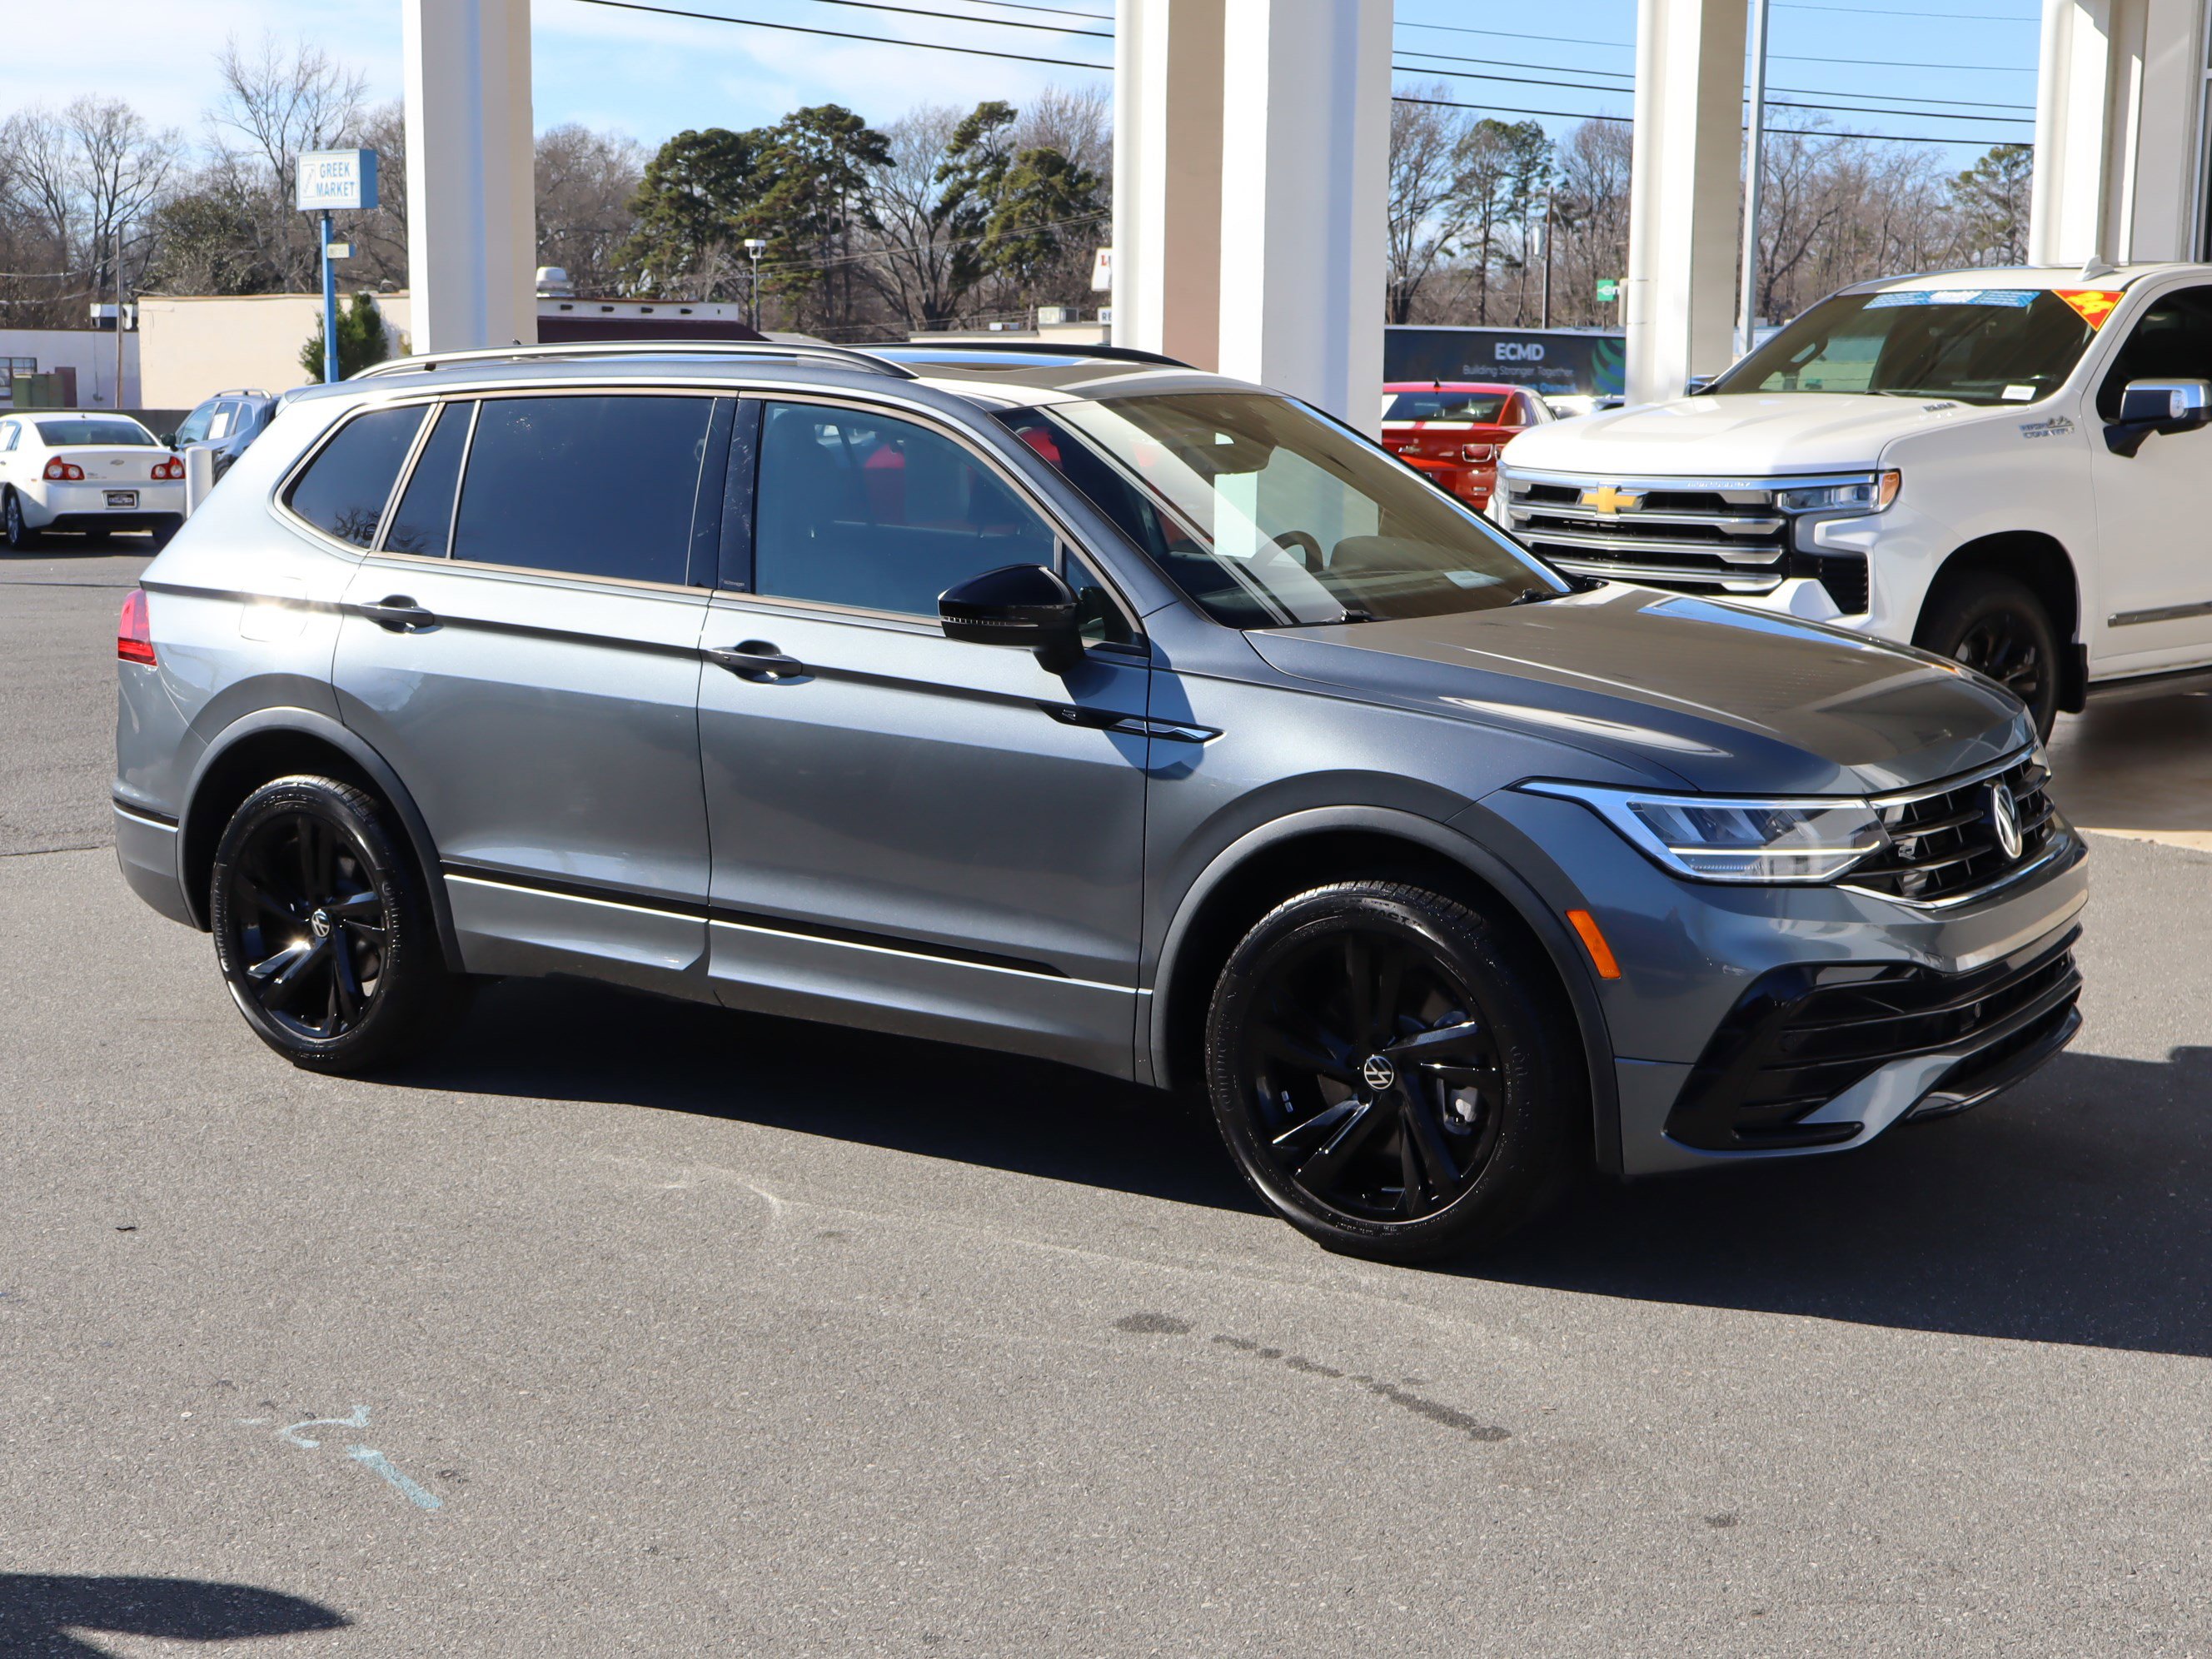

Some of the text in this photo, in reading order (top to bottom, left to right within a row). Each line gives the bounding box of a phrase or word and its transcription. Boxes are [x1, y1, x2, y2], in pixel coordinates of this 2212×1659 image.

[320, 162, 351, 178] GREEK
[316, 182, 355, 197] MARKET
[1495, 342, 1545, 361] ECMD
[1462, 365, 1498, 377] Building
[1499, 366, 1535, 377] Stronger
